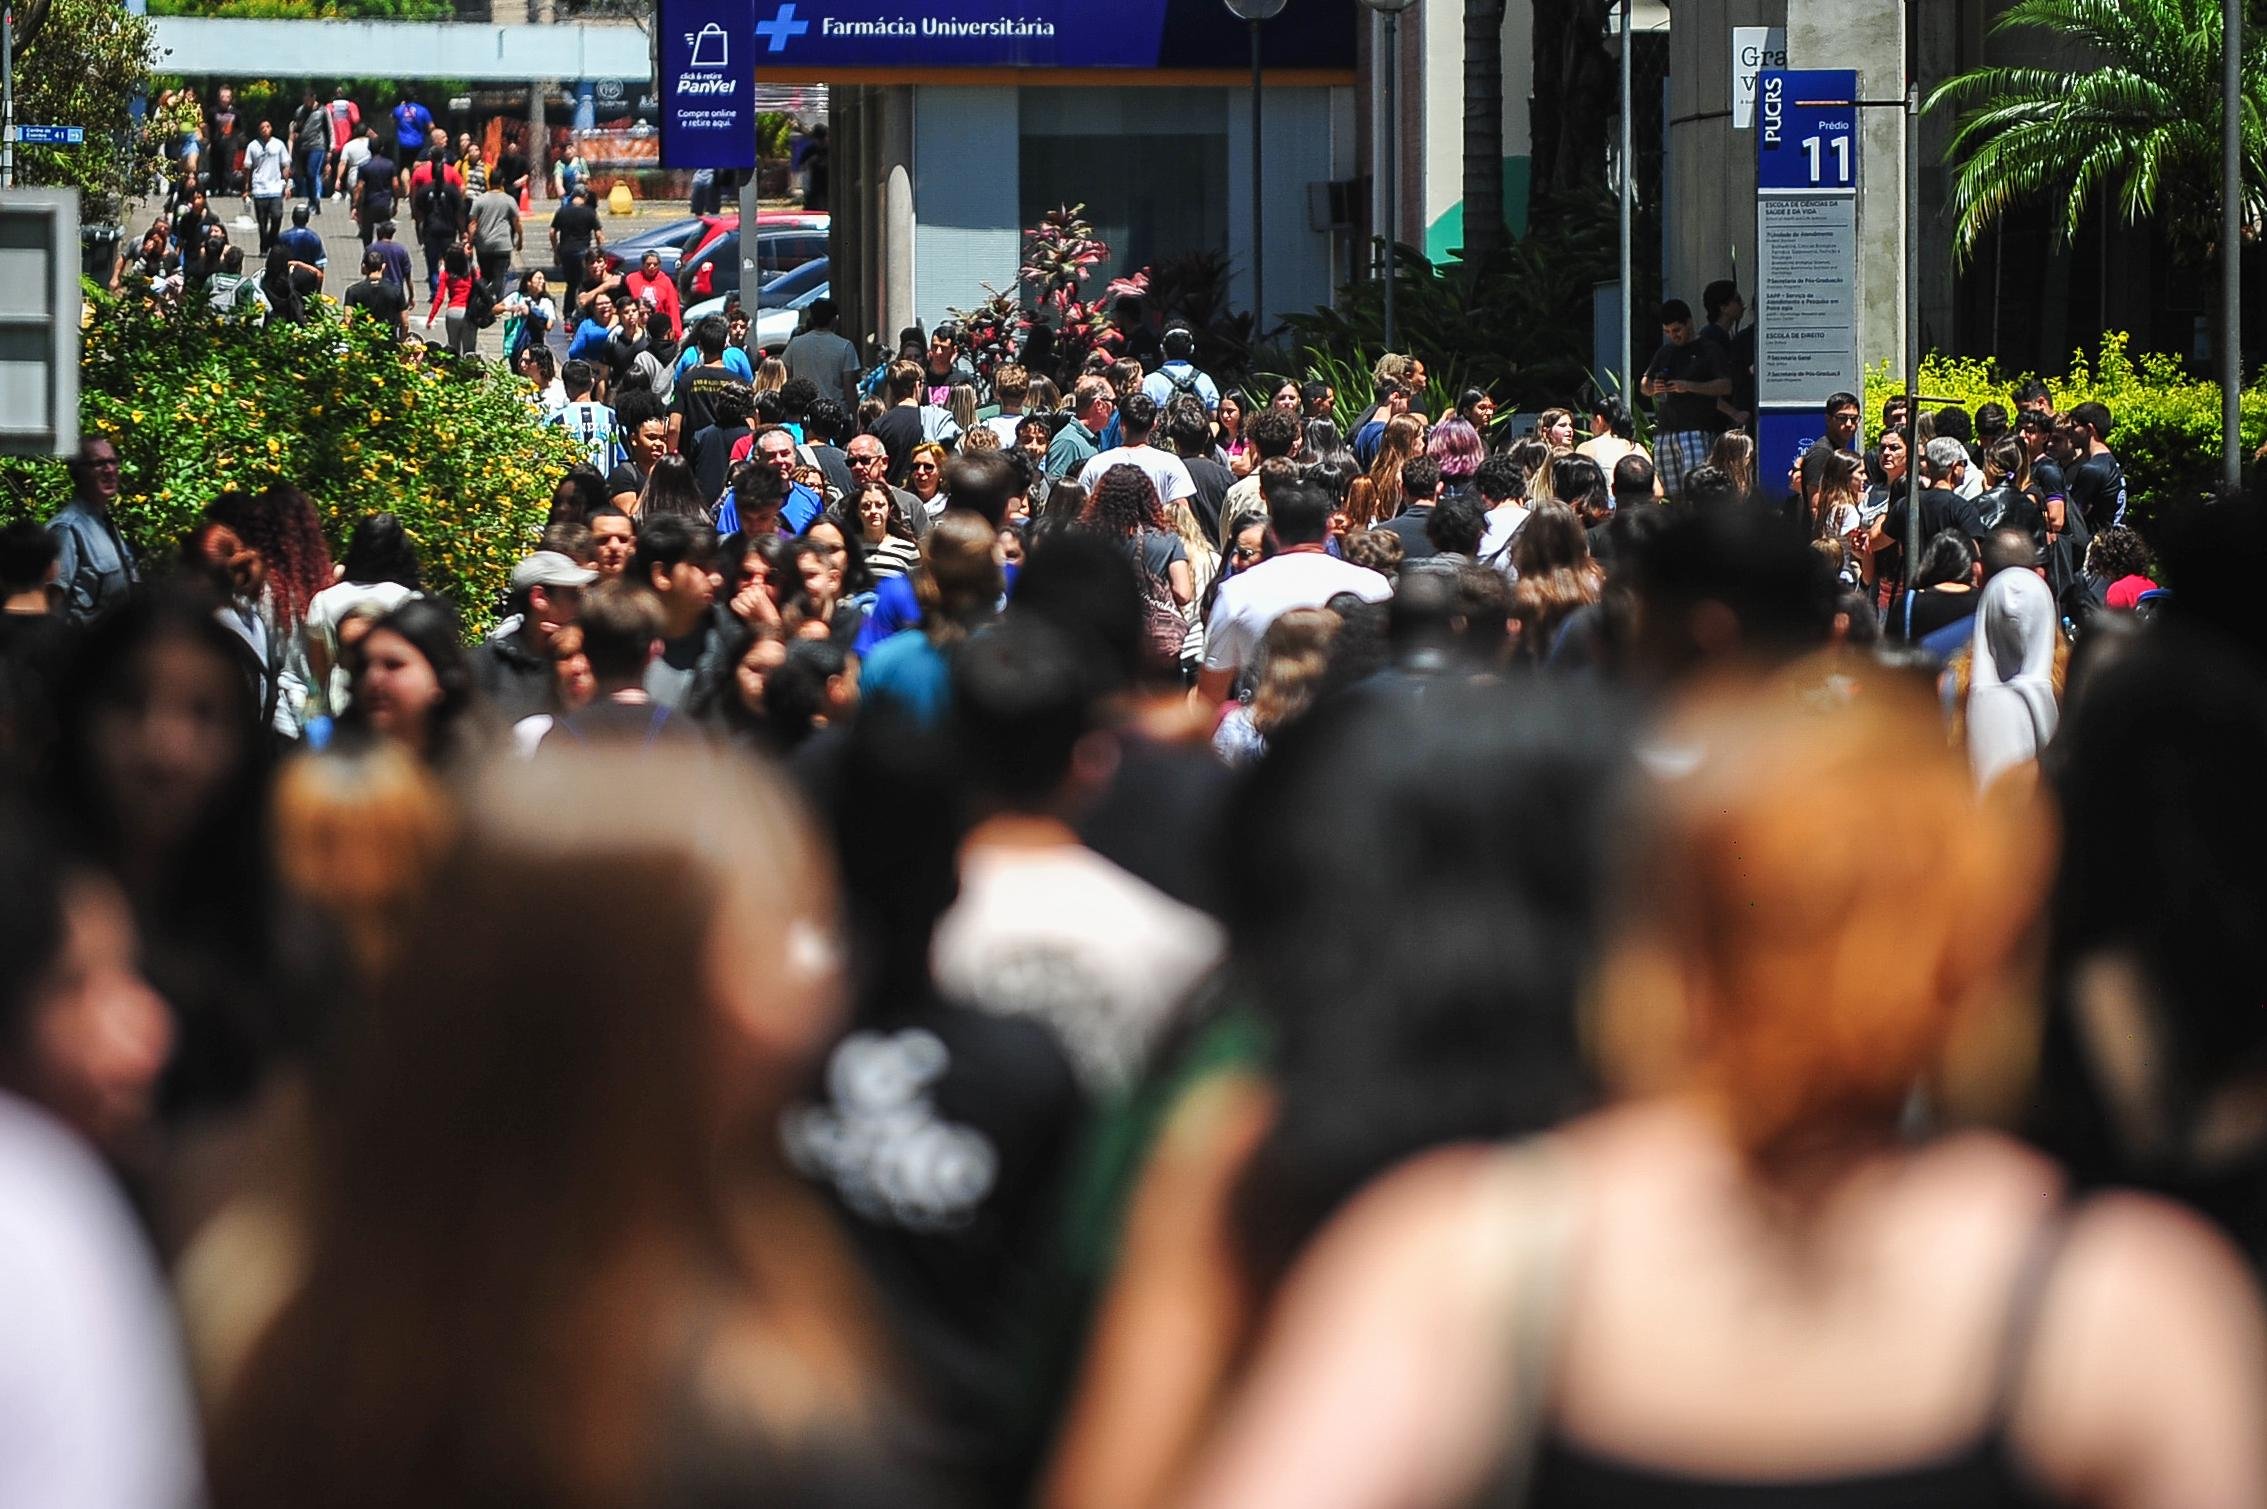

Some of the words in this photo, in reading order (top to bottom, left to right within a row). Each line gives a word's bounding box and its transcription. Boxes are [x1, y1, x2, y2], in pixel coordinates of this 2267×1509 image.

[823, 16, 916, 35] Farmácia
[922, 16, 1054, 36] Universitária
[680, 72, 695, 80] click
[703, 72, 722, 80] retire
[677, 80, 736, 94] PanVel
[677, 109, 710, 118] Compre
[711, 109, 737, 117] online
[1765, 77, 1782, 142] PUCRS
[688, 119, 711, 127] retire
[1818, 120, 1849, 130] Prédio
[1802, 135, 1849, 182] 11
